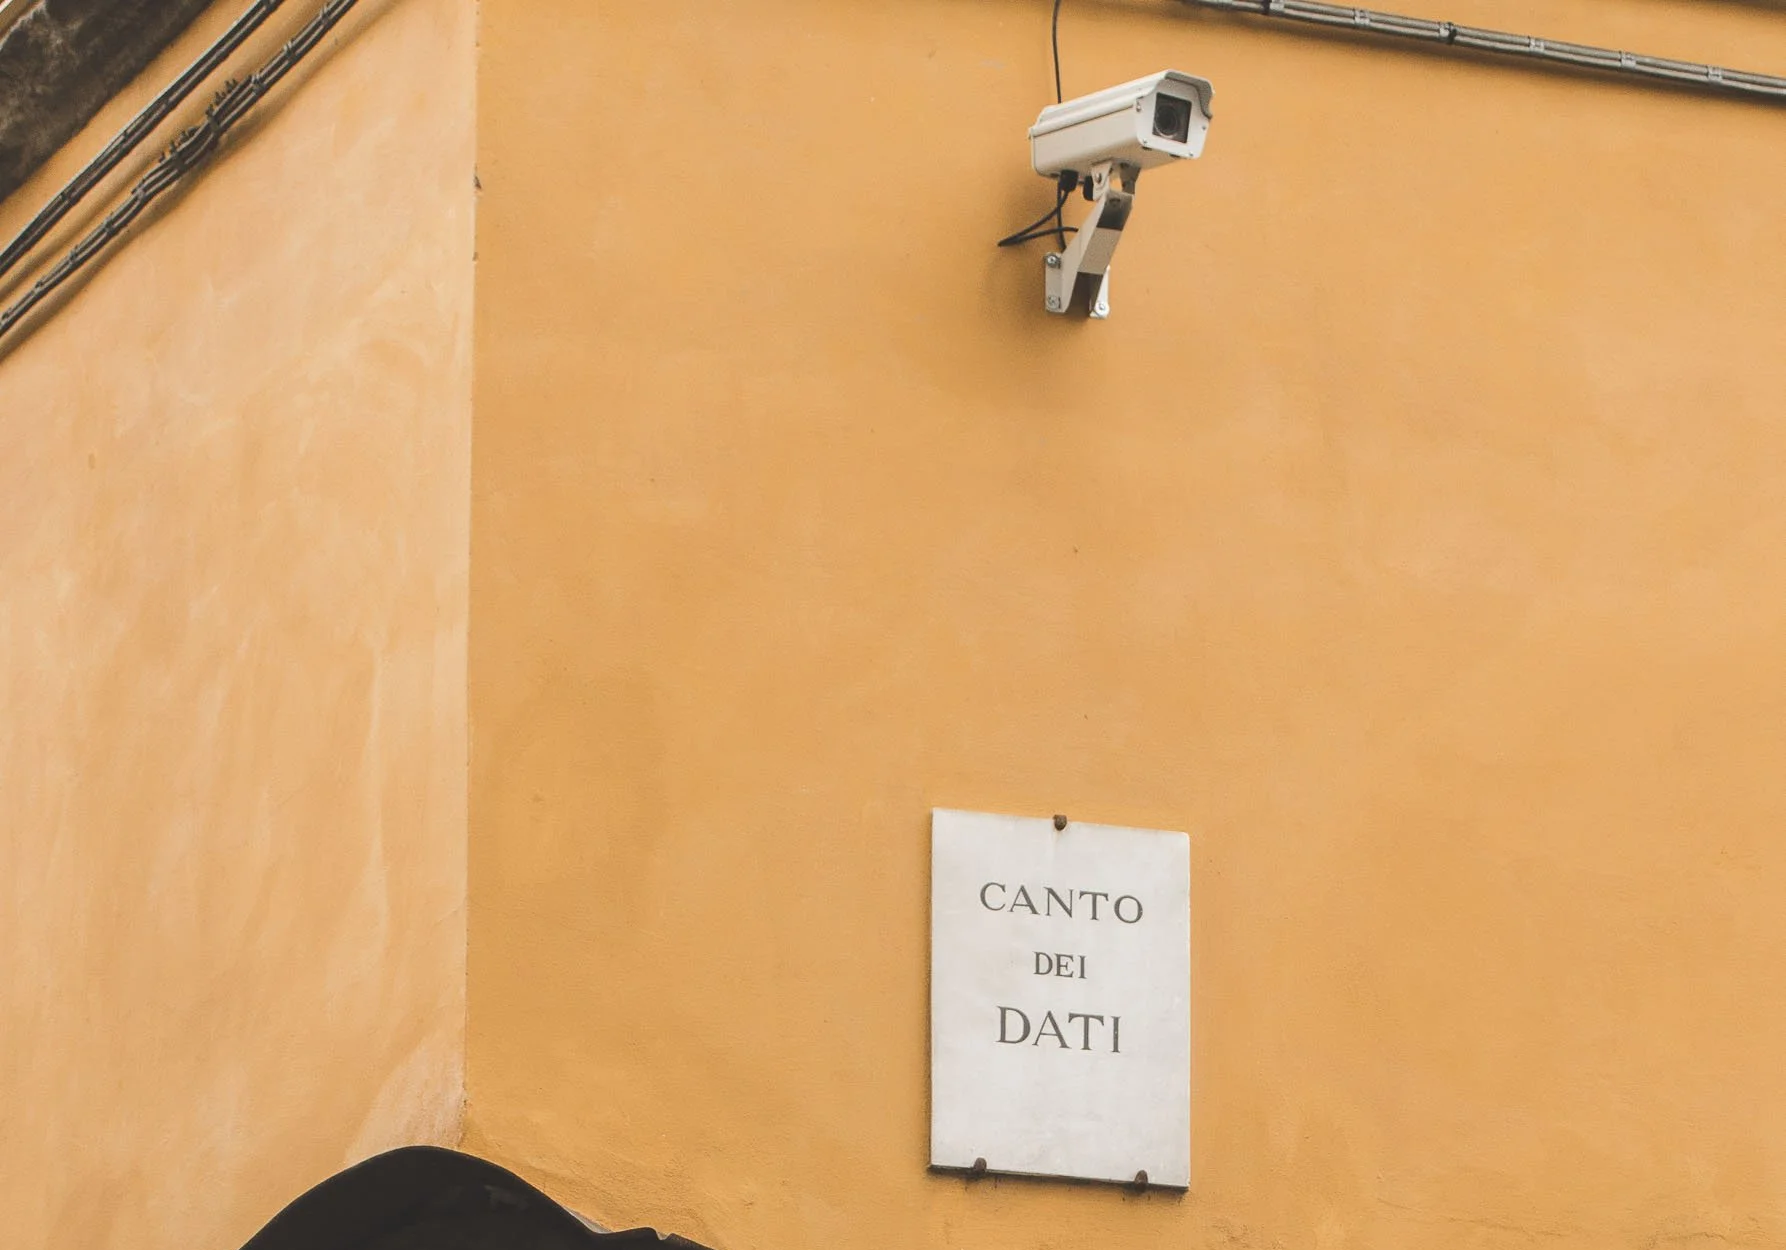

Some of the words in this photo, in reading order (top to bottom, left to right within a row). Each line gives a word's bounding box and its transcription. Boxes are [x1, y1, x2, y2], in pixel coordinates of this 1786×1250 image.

[980, 882, 1143, 924] CANTO
[1033, 951, 1087, 979] DEI
[996, 1005, 1121, 1053] DATI
